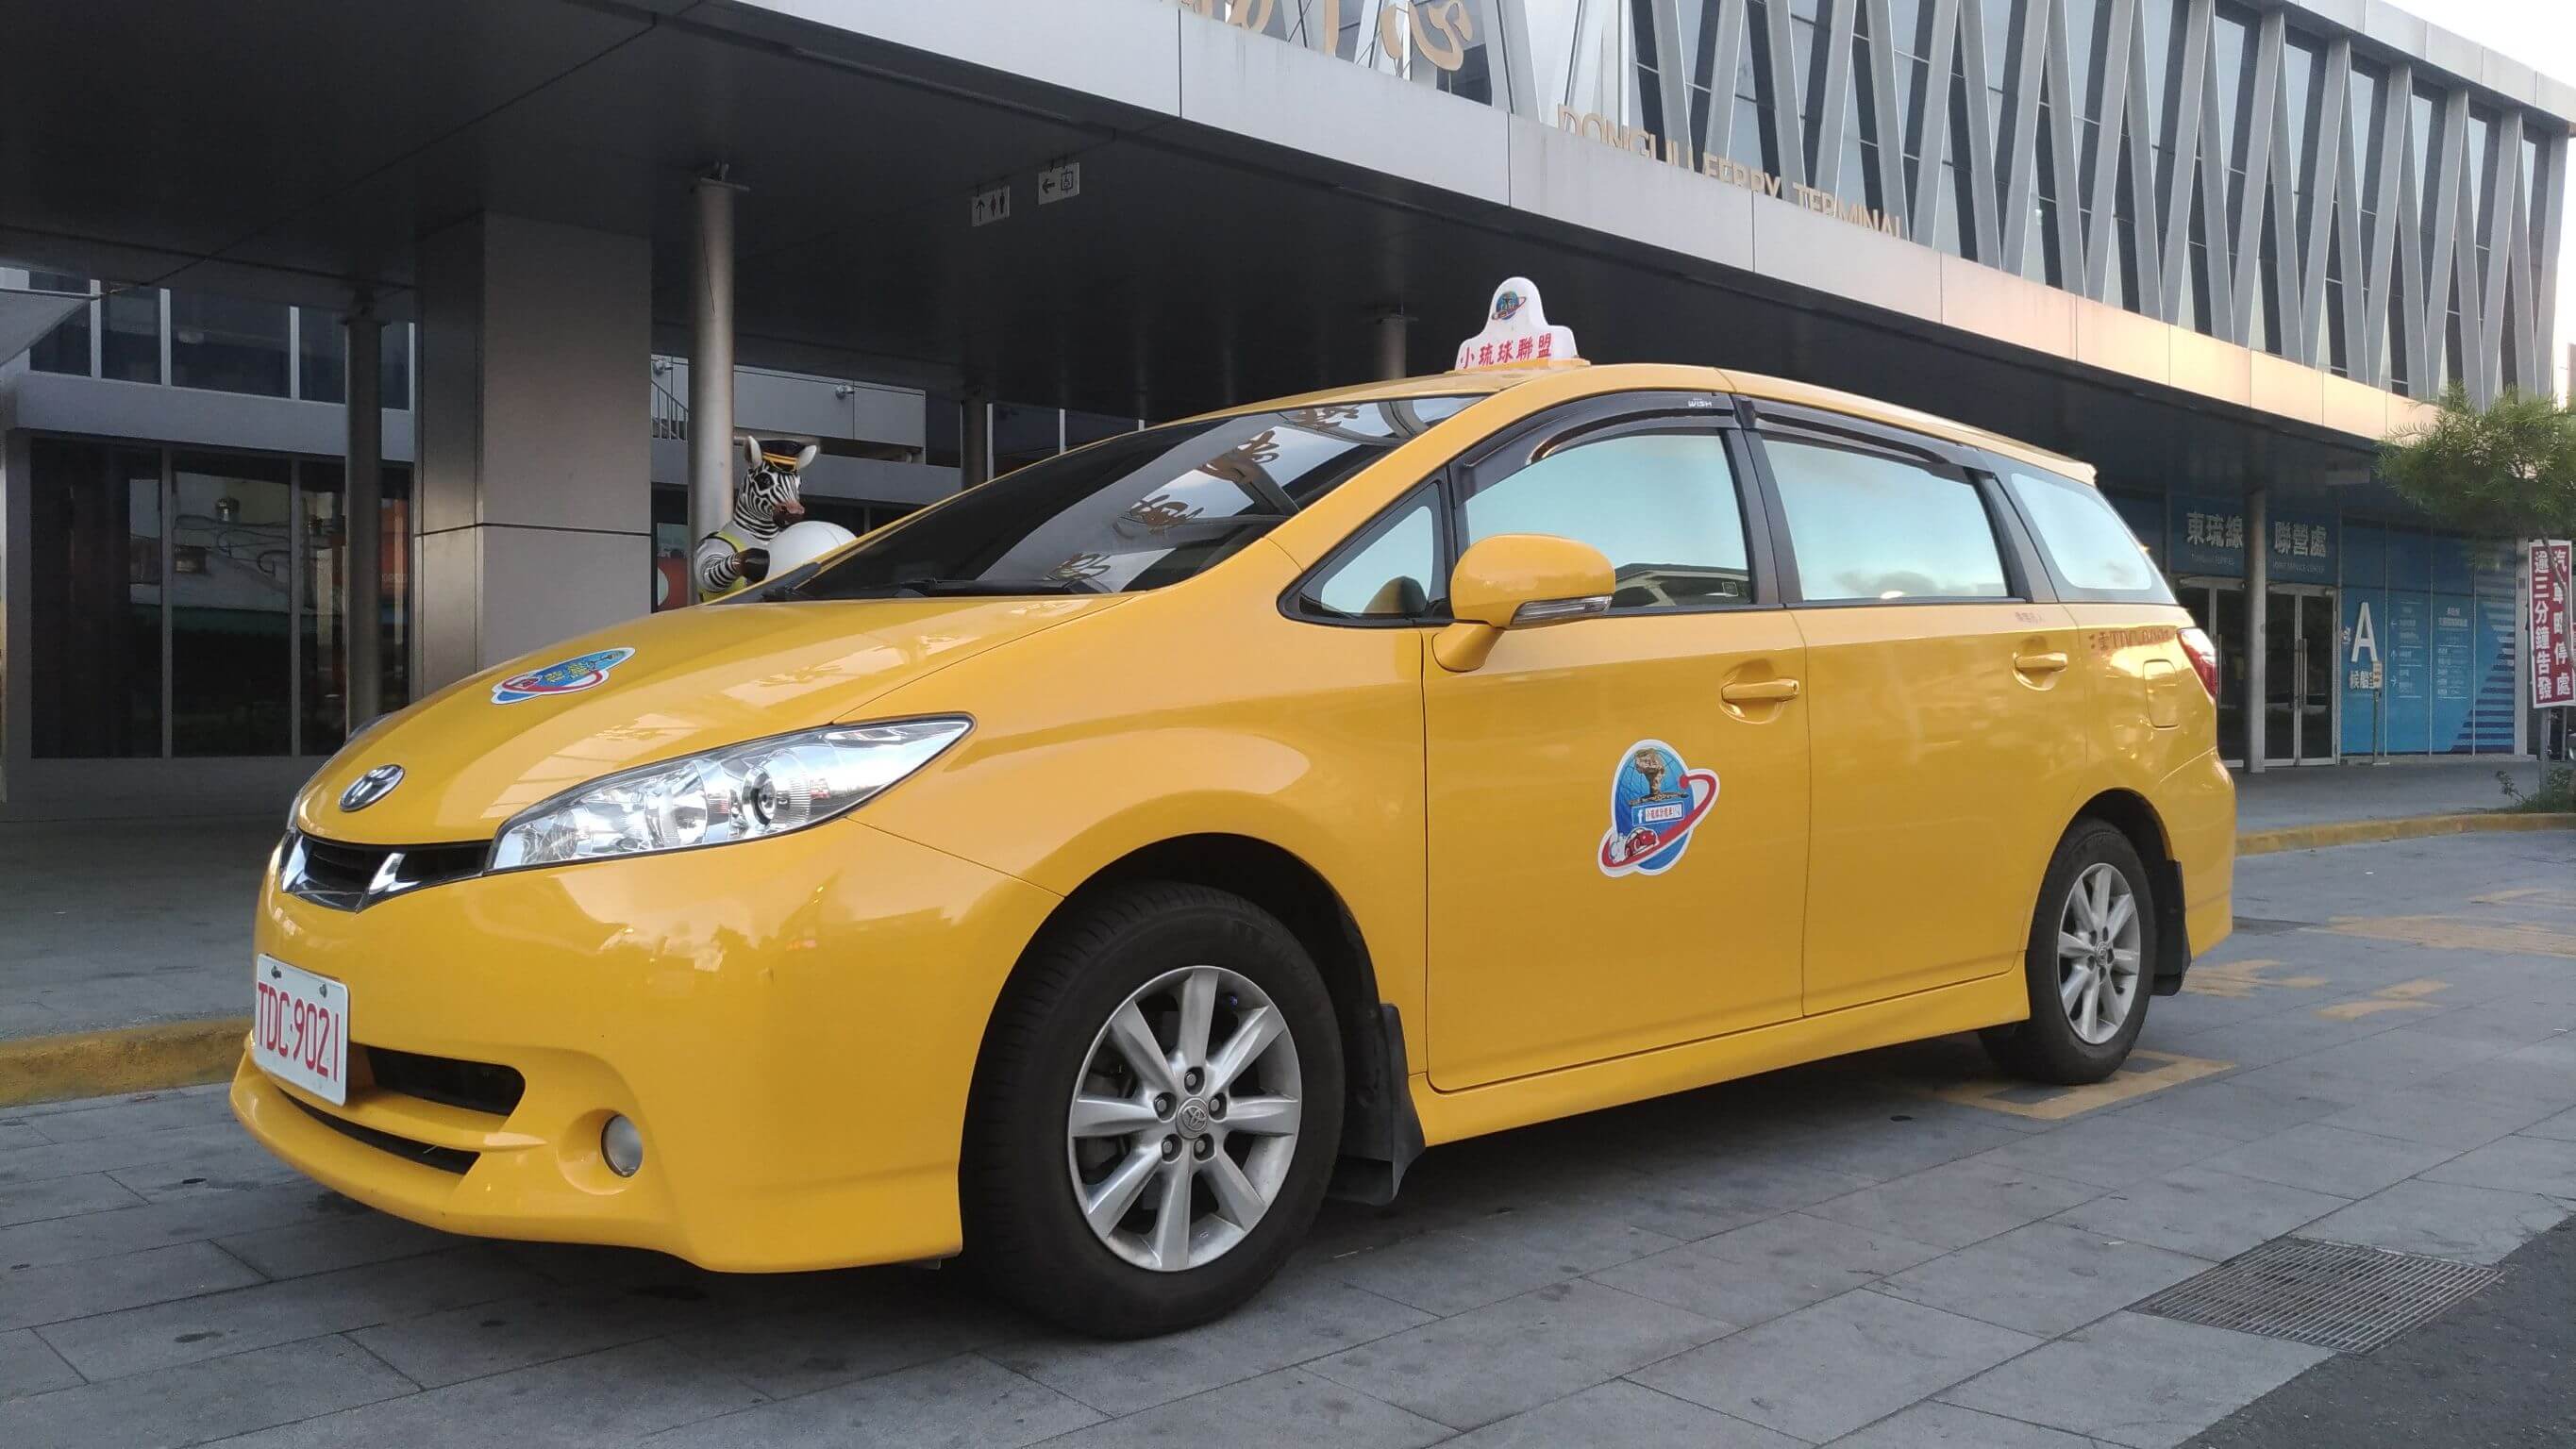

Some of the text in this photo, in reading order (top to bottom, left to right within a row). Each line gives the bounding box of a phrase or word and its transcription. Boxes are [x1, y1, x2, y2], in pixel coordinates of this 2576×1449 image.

[1461, 332, 1552, 369] 小琉球聯盟
[2186, 511, 2327, 558] 東琉線 聯營處
[2350, 602, 2378, 662] A
